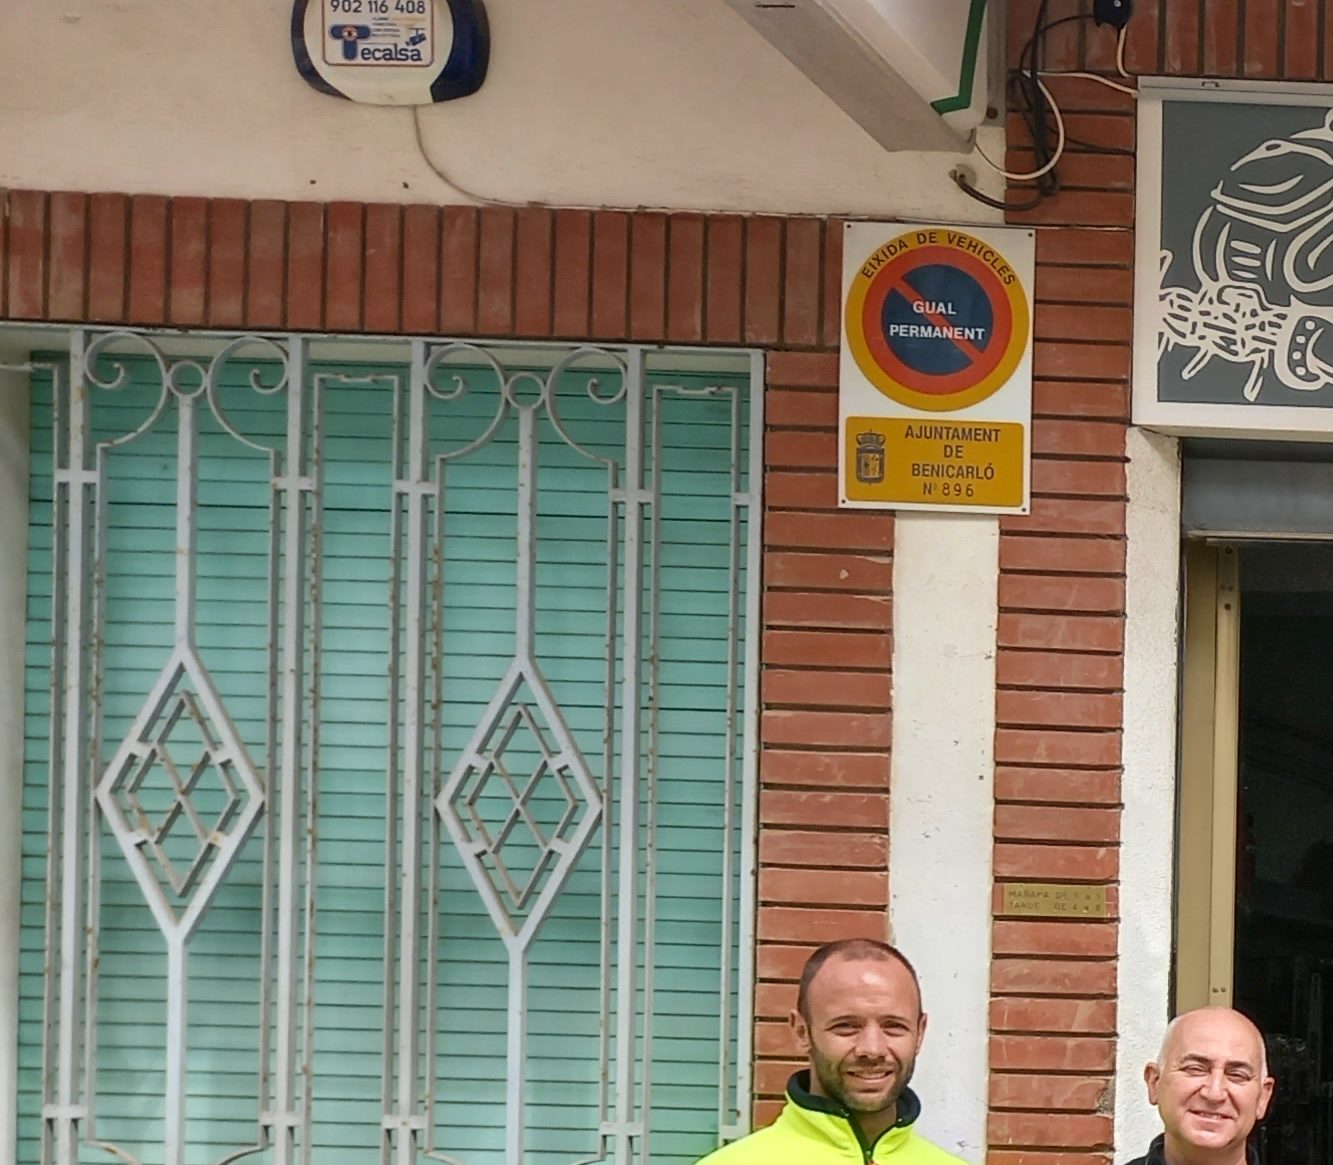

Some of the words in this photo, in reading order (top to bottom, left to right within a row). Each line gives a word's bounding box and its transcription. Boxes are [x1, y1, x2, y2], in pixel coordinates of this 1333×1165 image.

[331, 0, 361, 13] 902
[368, 0, 389, 13] 116
[395, 0, 426, 14] 408
[863, 239, 908, 278] EIXIDA
[917, 232, 938, 245] DE
[947, 233, 1016, 286] VEHICLES
[913, 301, 957, 315] GUAL
[889, 324, 986, 341] PERMANENT
[904, 425, 1001, 442] AJUNTAMENT
[943, 445, 963, 459] DE
[911, 463, 995, 481] BENICARLÓ
[942, 482, 974, 497] 896
